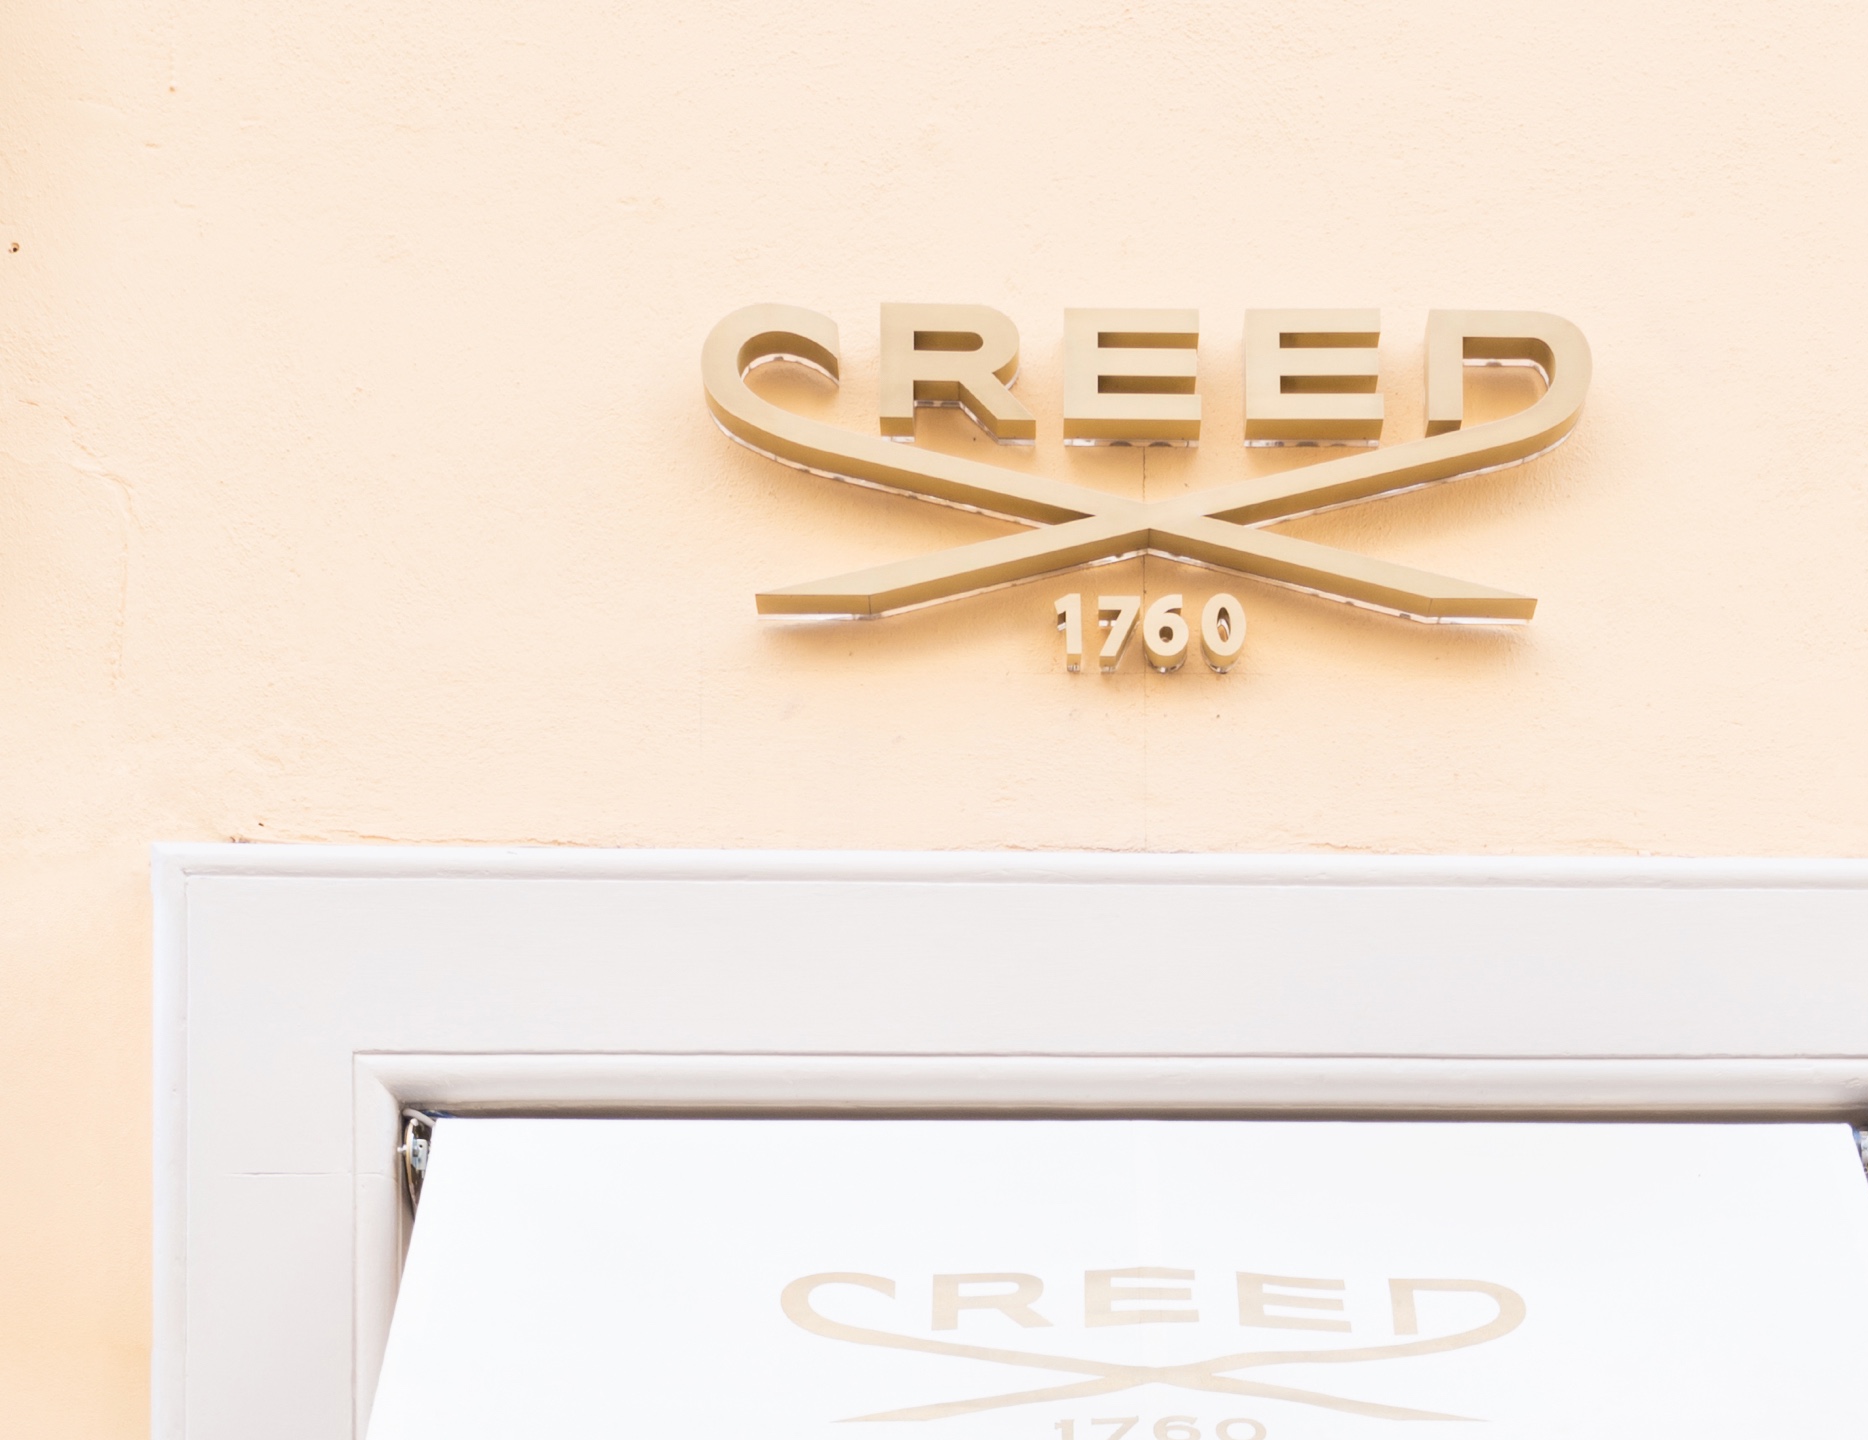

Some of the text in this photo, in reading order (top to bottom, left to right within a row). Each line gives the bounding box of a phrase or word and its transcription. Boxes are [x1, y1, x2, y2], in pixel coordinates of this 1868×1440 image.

[700, 302, 1593, 480] CREED
[1053, 592, 1247, 673] 1760
[779, 1266, 1528, 1360] CREED
